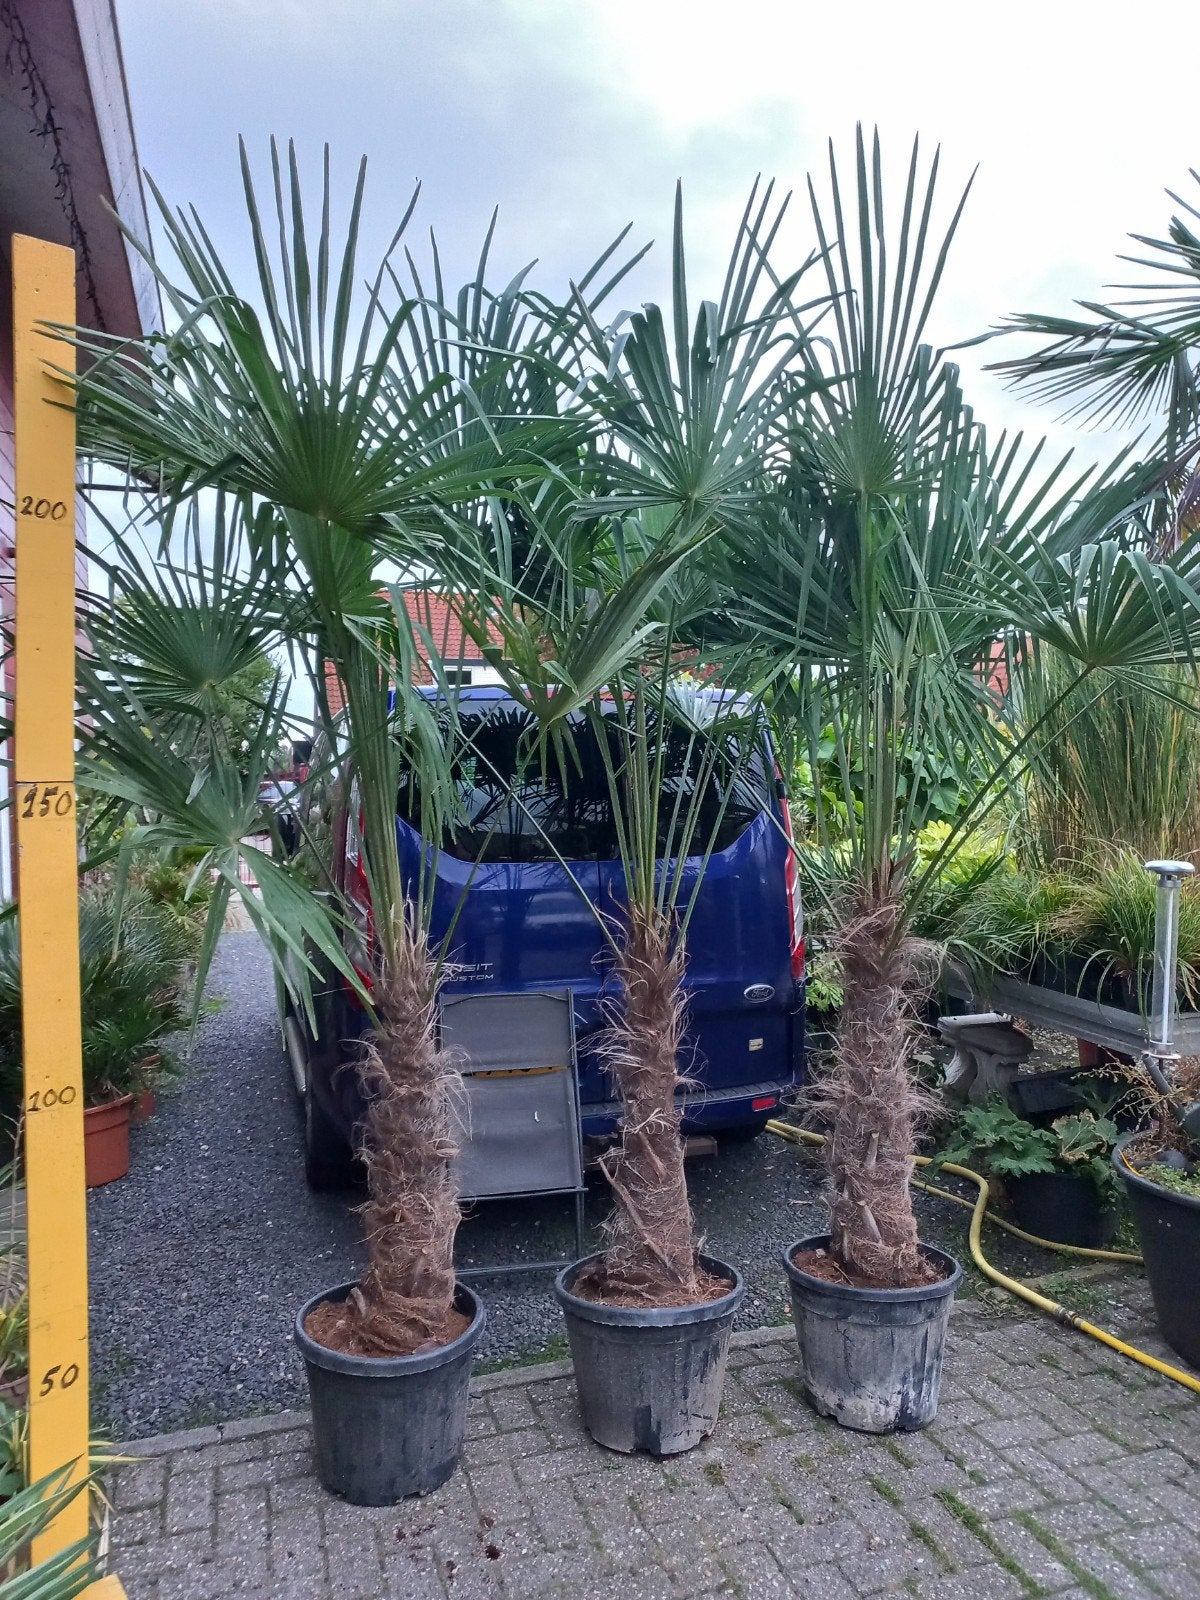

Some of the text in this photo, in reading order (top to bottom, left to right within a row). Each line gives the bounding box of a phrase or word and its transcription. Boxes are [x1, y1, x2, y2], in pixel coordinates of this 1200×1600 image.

[20, 495, 67, 521] 200
[21, 783, 73, 818] 150
[26, 1085, 76, 1112] 100
[39, 1363, 80, 1397] 50
